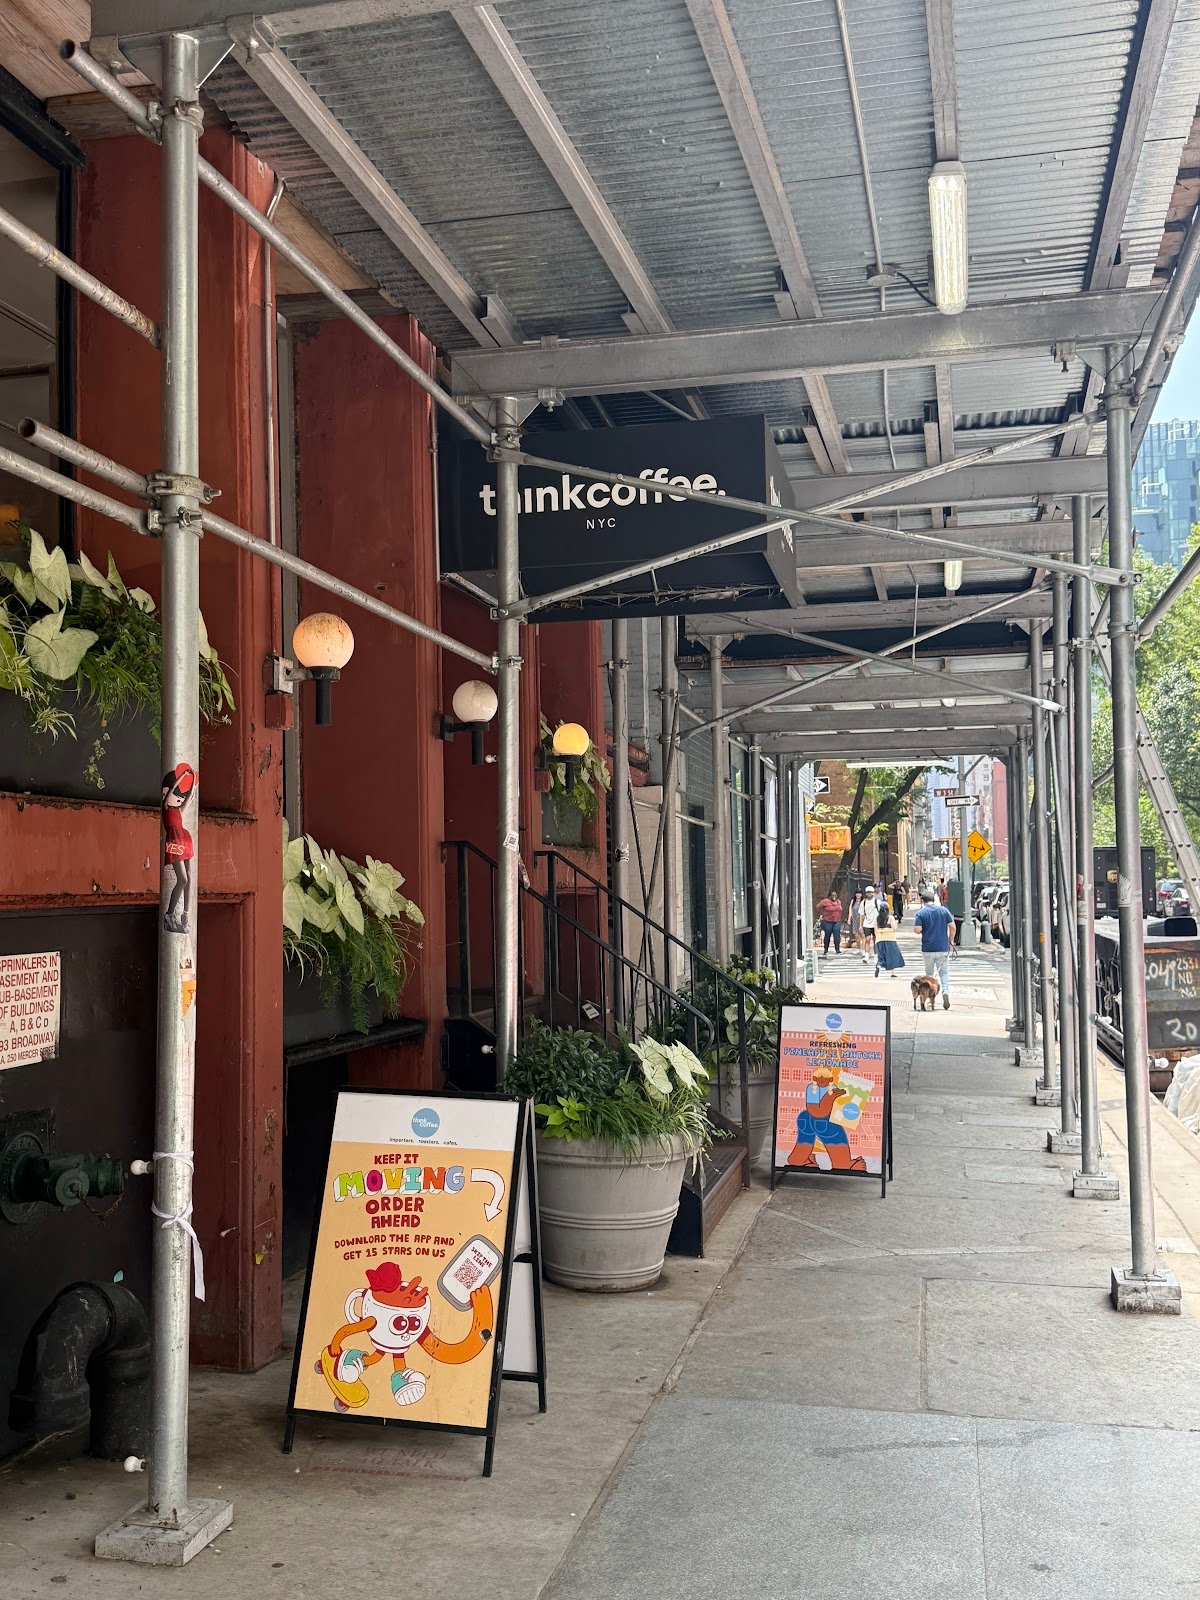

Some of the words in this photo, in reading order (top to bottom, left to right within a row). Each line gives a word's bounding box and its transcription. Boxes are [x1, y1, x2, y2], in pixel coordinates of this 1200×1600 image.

[479, 467, 726, 516] tinkcoffee.
[586, 517, 616, 529] NYC
[166, 842, 185, 856] YES
[50, 955, 57, 967] IN
[42, 970, 58, 983] AND
[11, 1000, 54, 1018] BUILDINGS
[21, 1018, 26, 1031] B
[28, 1018, 33, 1030] &
[36, 1016, 41, 1029] C
[12, 1031, 55, 1049] BROADWAY
[809, 1040, 857, 1049] REFRESHING
[18, 1049, 38, 1060] MERCER
[784, 1047, 837, 1058] PINEAPPLE
[841, 1050, 882, 1060] MATCHA
[806, 1058, 859, 1068] LEMONADE
[374, 1154, 401, 1165] KEEP
[404, 1154, 419, 1164] IT
[333, 1165, 465, 1202] MOVING
[366, 1196, 425, 1214] ORDER
[371, 1215, 420, 1229] AHEAD
[335, 1235, 386, 1249] DOWNLOAD
[389, 1234, 410, 1243] THE
[414, 1234, 432, 1243] APP
[434, 1236, 455, 1246] AND
[343, 1250, 362, 1260] GET
[366, 1248, 378, 1257] 15
[382, 1247, 412, 1256] STARS
[415, 1247, 430, 1256] ON
[432, 1249, 446, 1258] US
[471, 1246, 483, 1260] SKIP
[482, 1256, 493, 1269] THE
